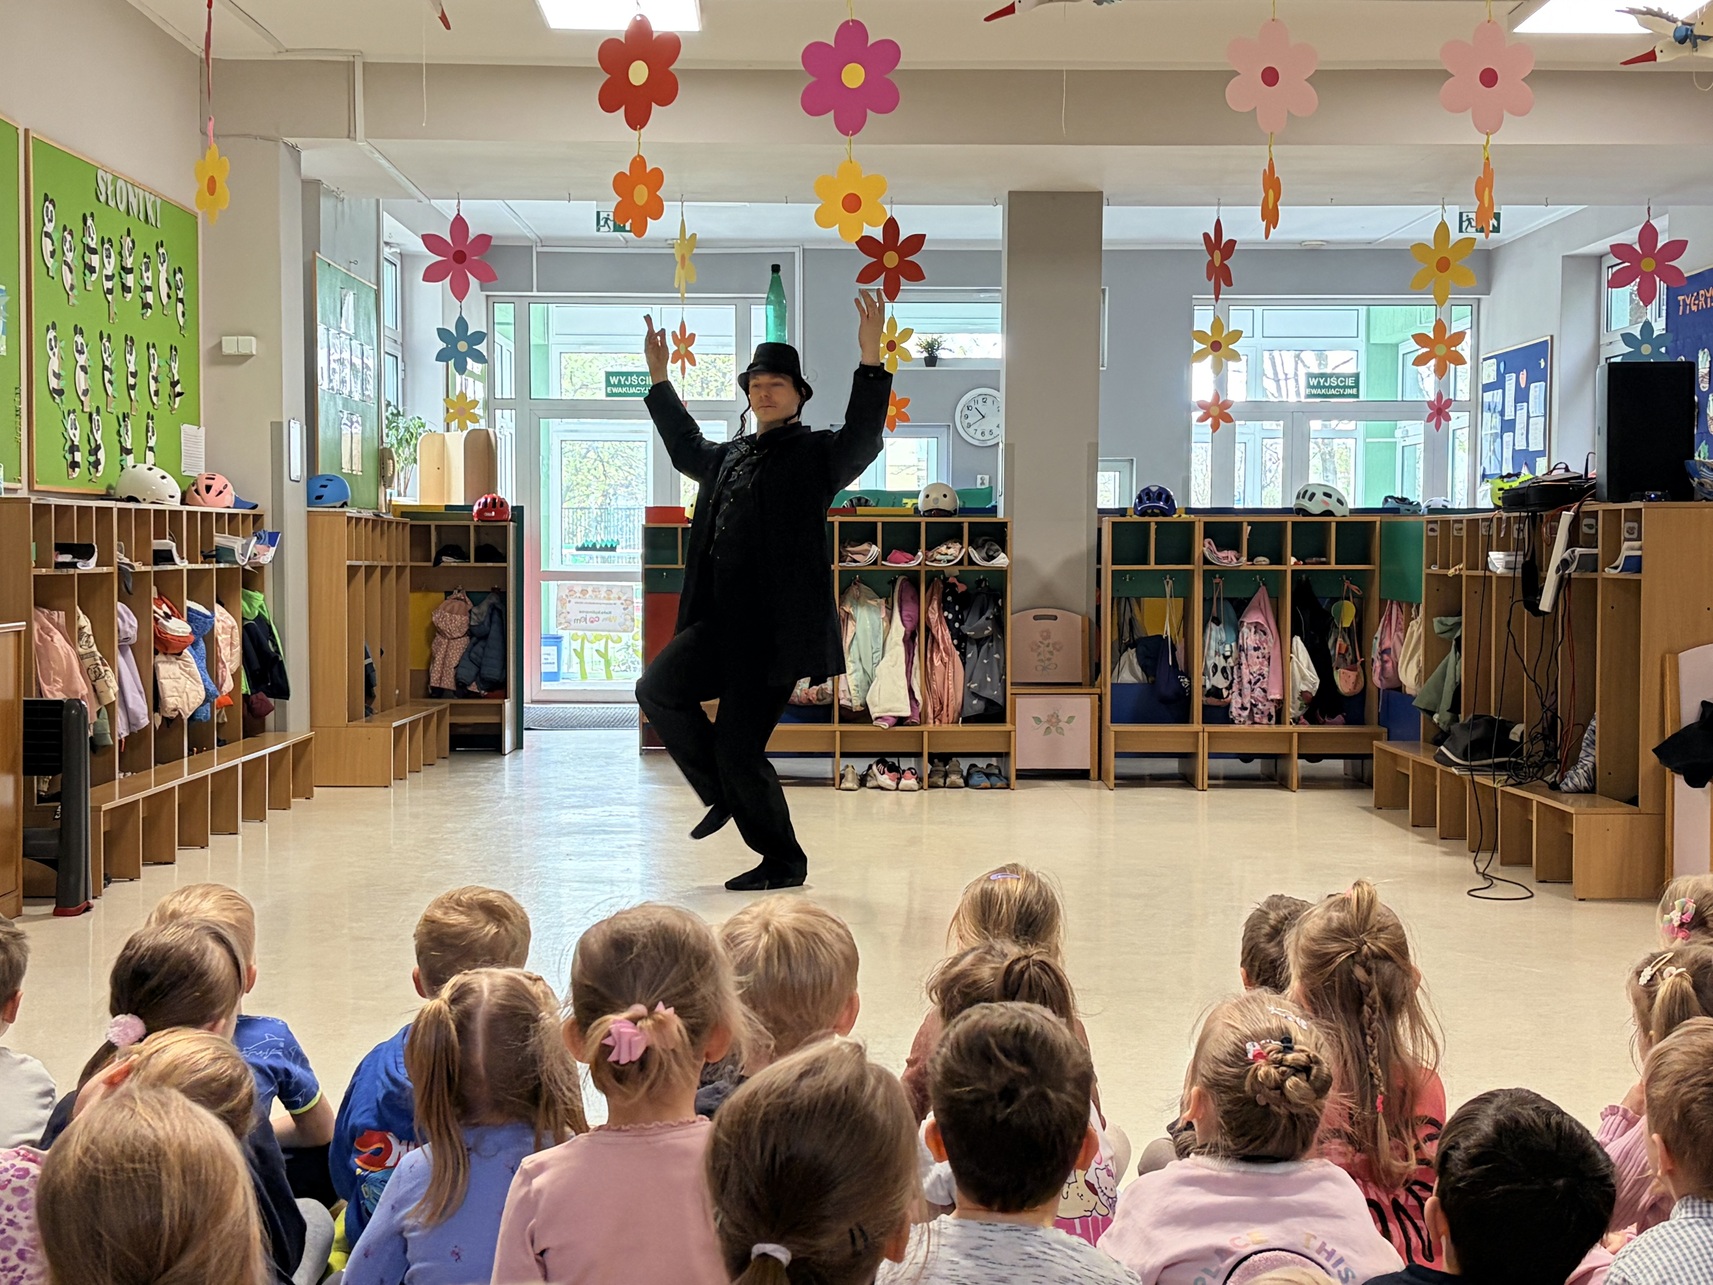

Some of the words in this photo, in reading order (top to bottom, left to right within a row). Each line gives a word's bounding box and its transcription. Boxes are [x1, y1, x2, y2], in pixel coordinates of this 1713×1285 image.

[96, 168, 161, 229] SŁONIKI
[1677, 286, 1713, 316] TYGRY
[606, 386, 650, 394] EWAKUACYJ
[1308, 375, 1356, 386] WYJŚCIE
[1304, 1232, 1356, 1285] THIS
